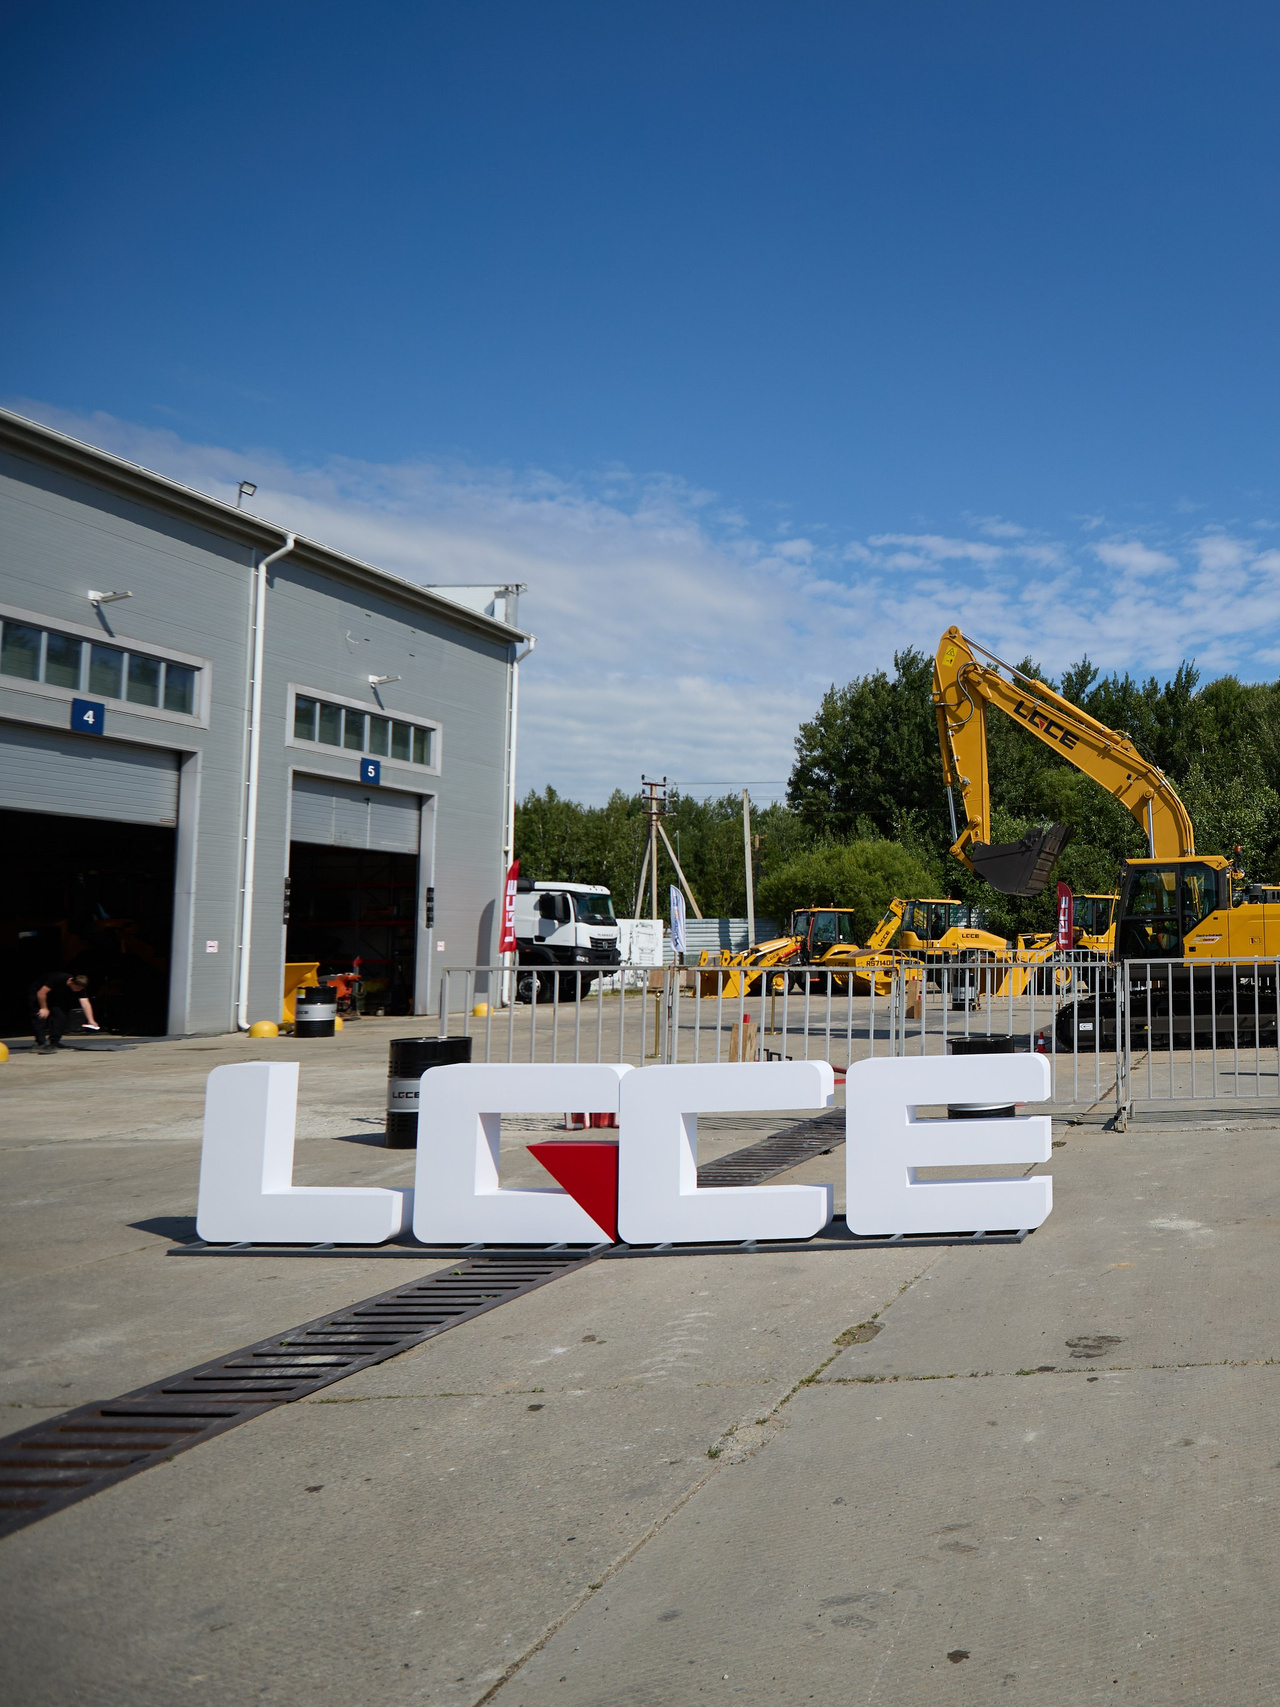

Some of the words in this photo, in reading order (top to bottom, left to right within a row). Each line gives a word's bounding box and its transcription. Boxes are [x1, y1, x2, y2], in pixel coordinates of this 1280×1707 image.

[83, 710, 95, 724] 4
[1013, 700, 1080, 751] LGCE
[367, 765, 375, 777] 5
[504, 880, 517, 942] LGCE
[196, 1055, 1053, 1245] LGCE
